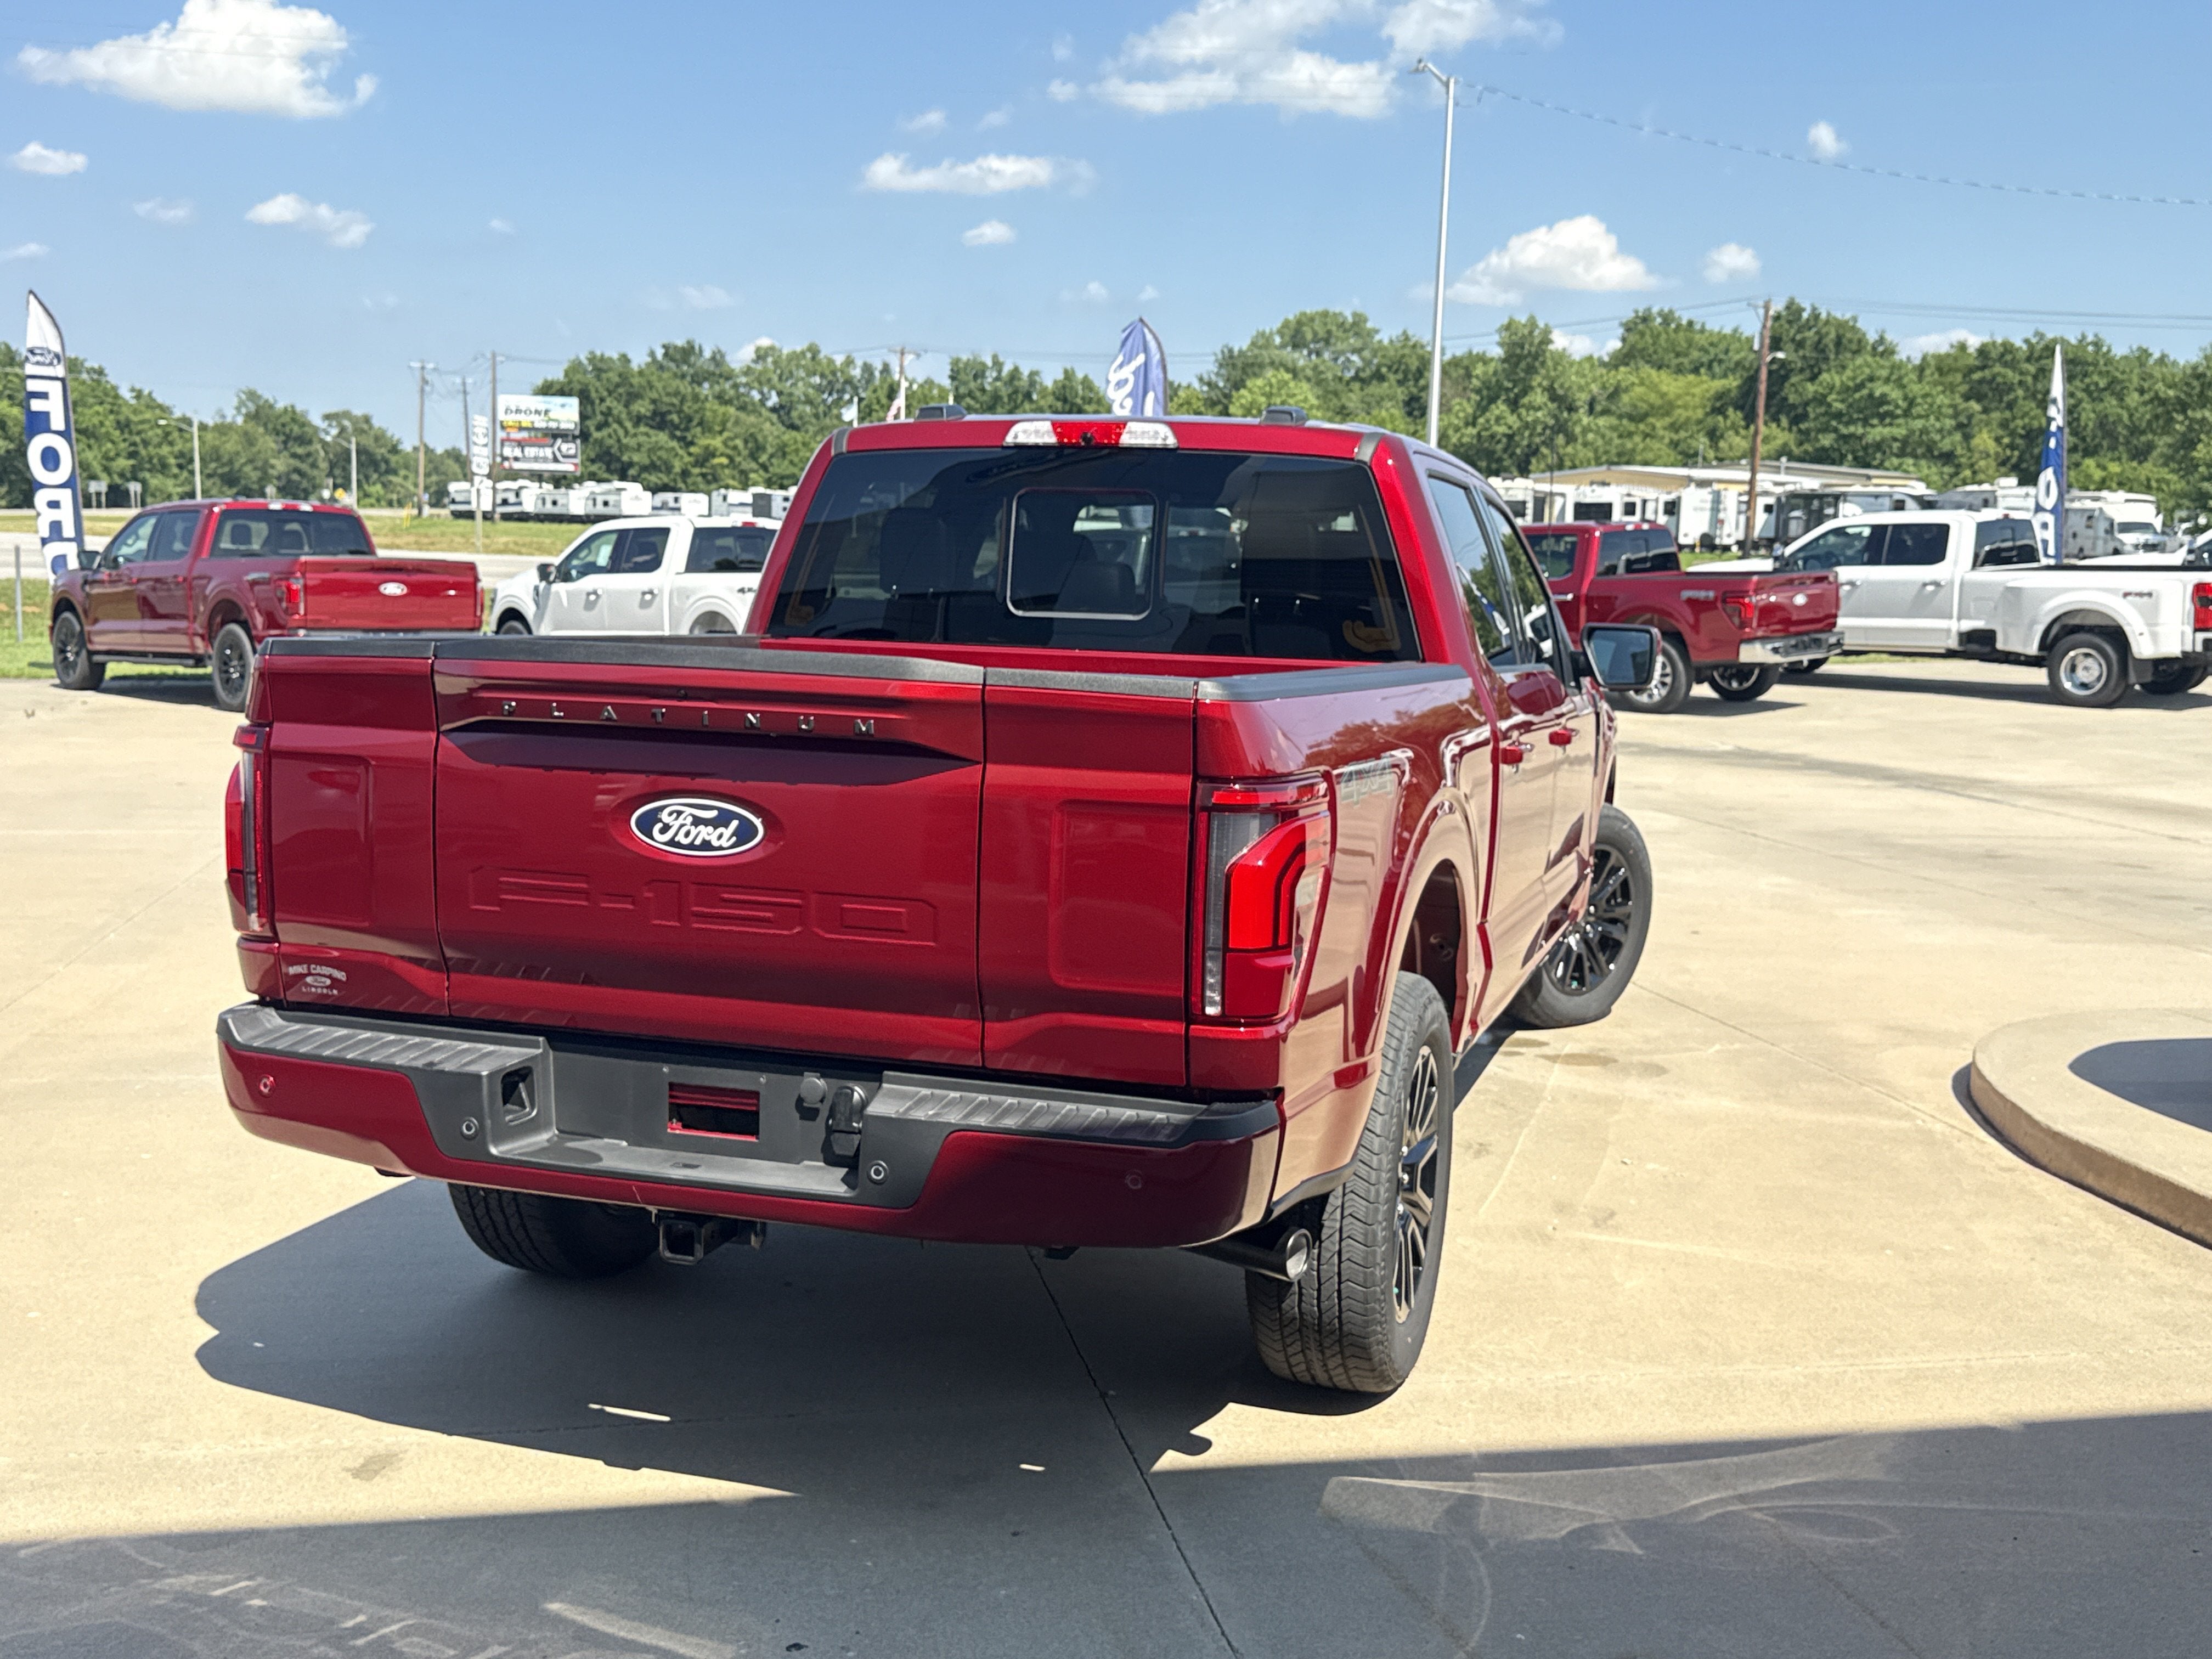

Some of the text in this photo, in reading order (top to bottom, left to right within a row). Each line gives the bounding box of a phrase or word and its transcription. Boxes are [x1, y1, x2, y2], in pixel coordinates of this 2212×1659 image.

[501, 701, 874, 736] PLATINUM
[652, 804, 740, 848] Ford
[469, 866, 937, 947] F-150
